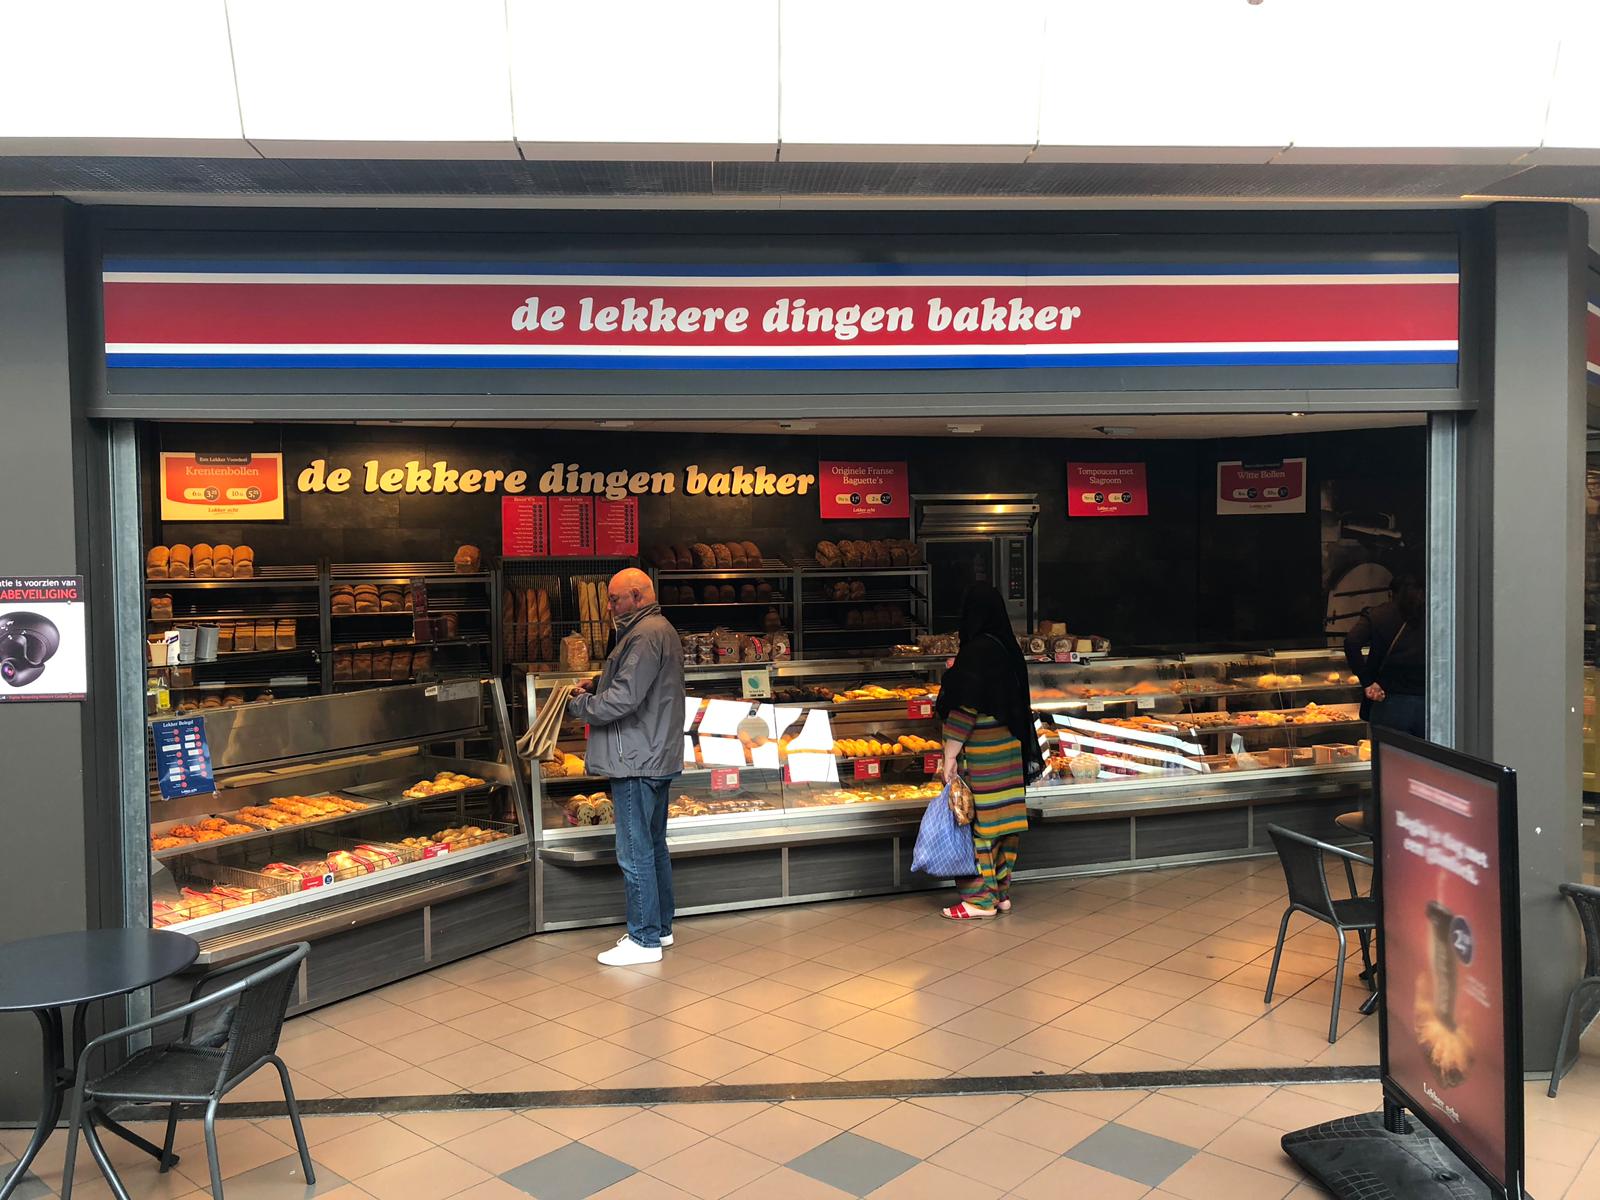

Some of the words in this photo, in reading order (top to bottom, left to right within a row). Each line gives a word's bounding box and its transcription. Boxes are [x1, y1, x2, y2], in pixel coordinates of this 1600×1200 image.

[511, 297, 566, 332] de
[579, 297, 749, 333] lekkere
[762, 298, 914, 340] dingen
[927, 298, 1081, 332] bakker
[185, 466, 259, 476] Krentenbollen
[831, 466, 866, 475] Originele
[867, 467, 894, 475] Franse
[297, 459, 351, 493] de
[363, 459, 526, 495] lekkere
[539, 463, 675, 500] dingen
[684, 465, 816, 496] bakker
[843, 476, 883, 485] Baguette's
[24, 579, 59, 587] voorzien
